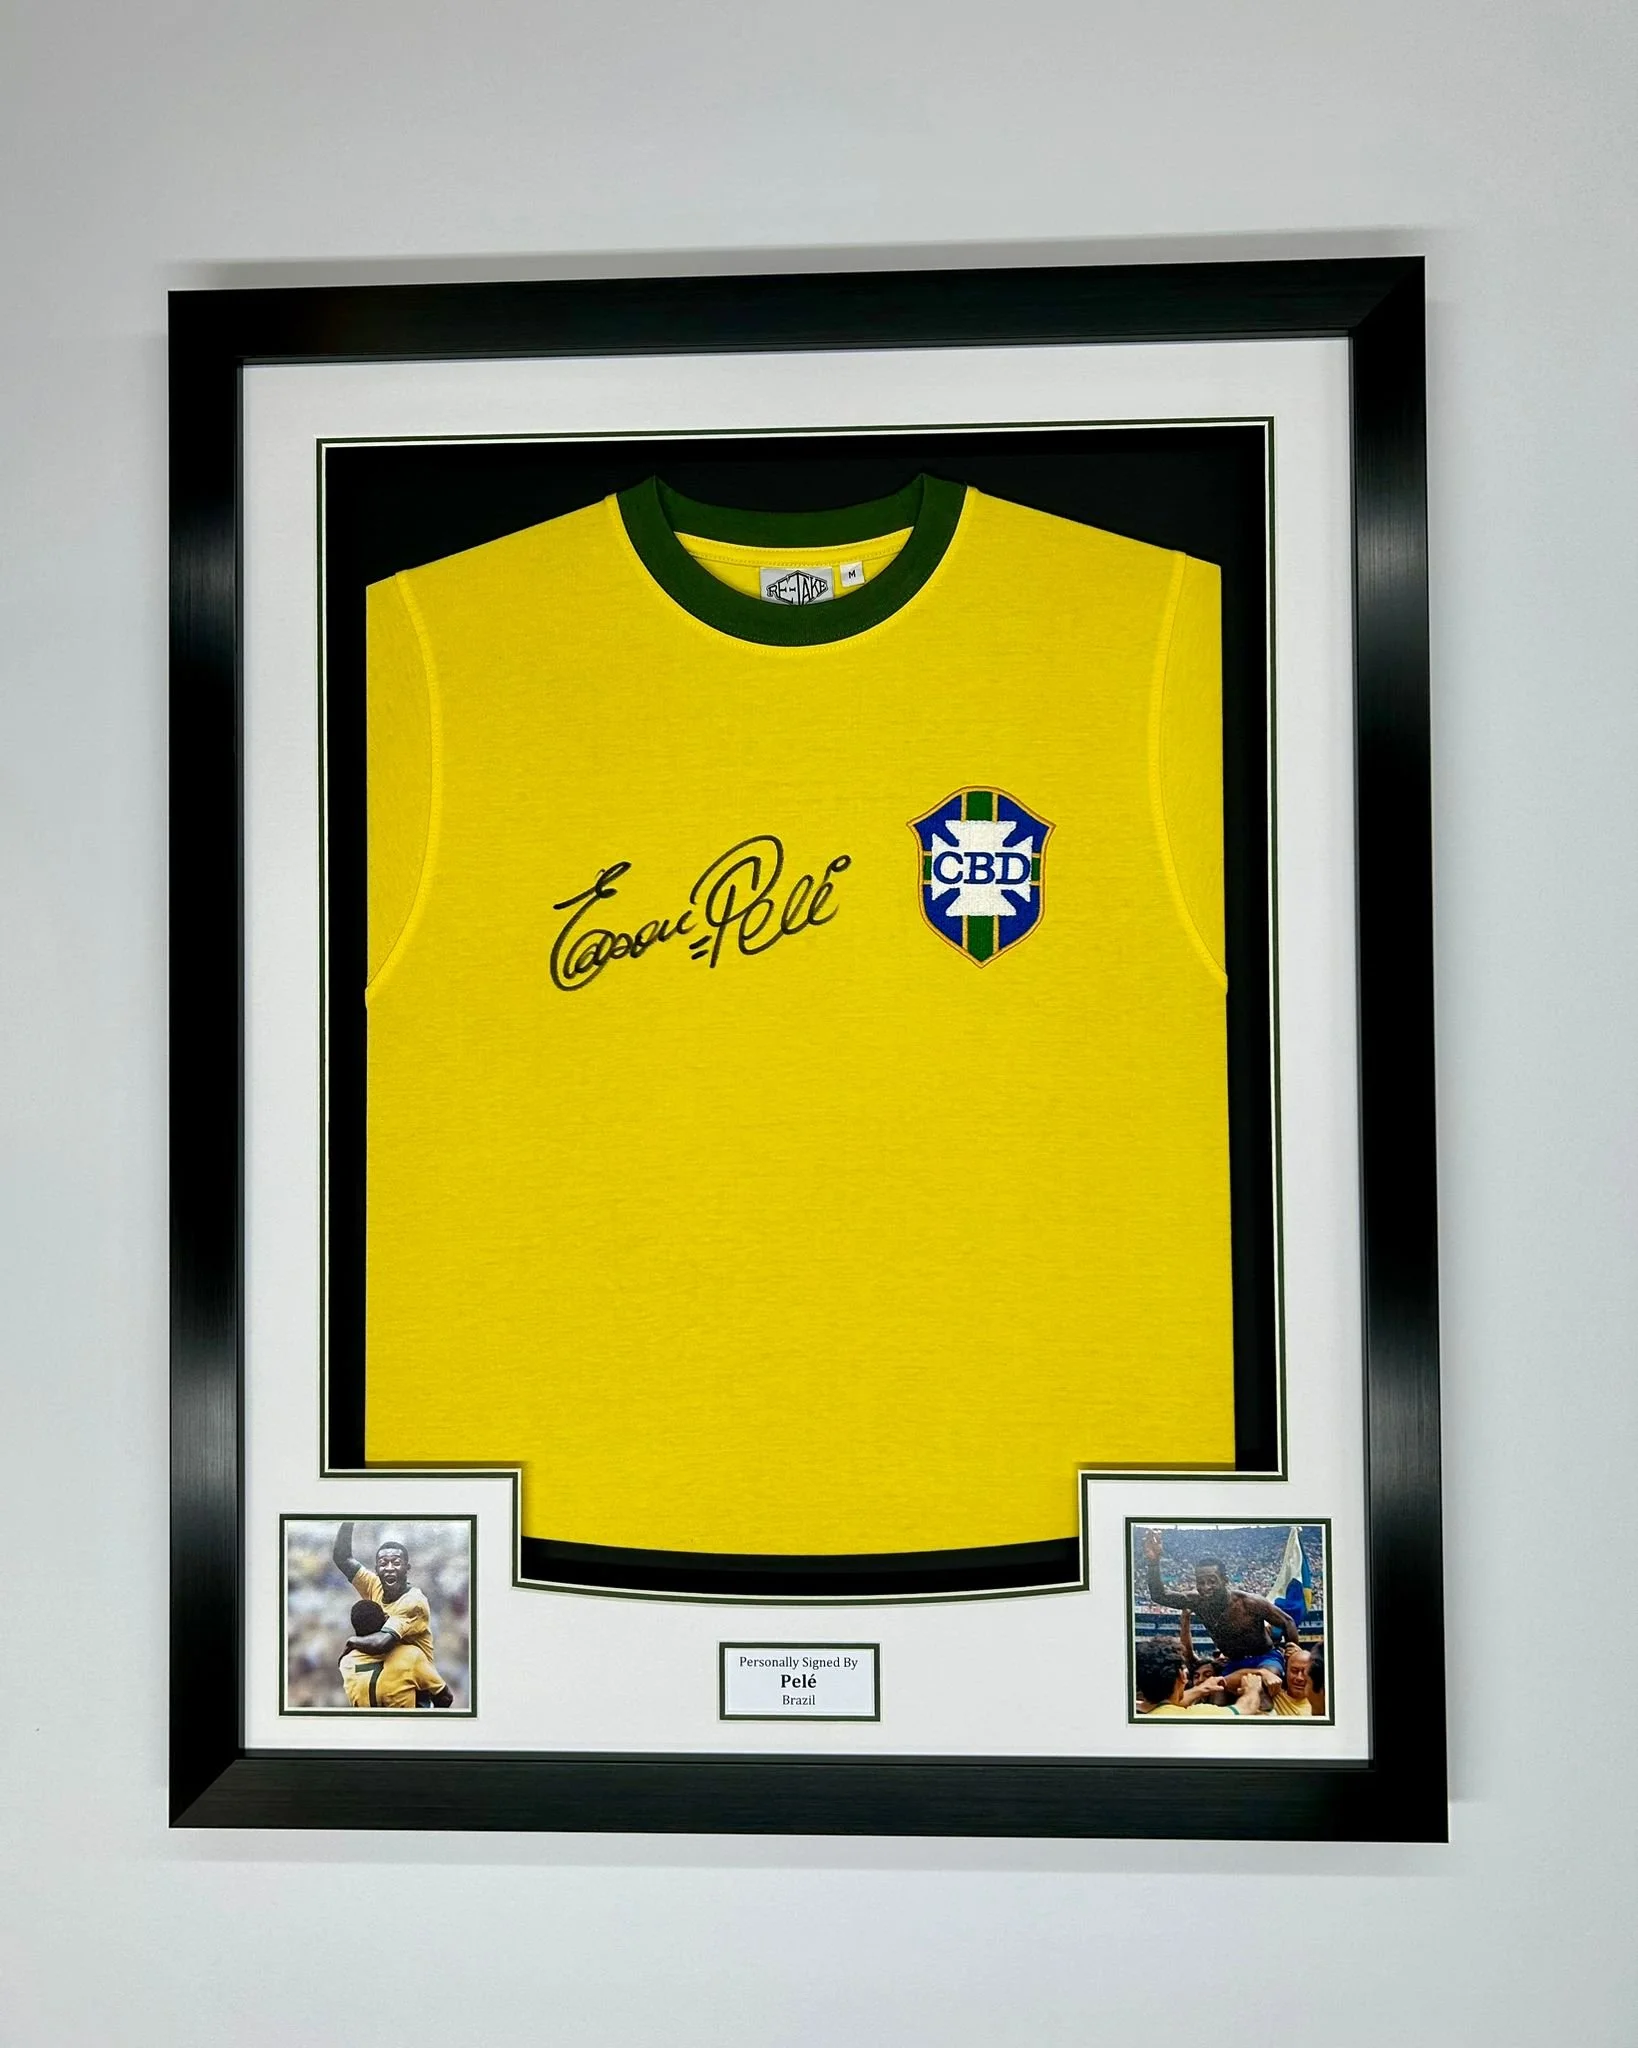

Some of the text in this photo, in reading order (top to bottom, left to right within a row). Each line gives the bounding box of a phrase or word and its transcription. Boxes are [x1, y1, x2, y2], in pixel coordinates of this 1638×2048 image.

[848, 570, 856, 579] M
[933, 851, 1031, 885] CBD
[739, 1656, 858, 1671] Personally Signed By
[355, 1662, 384, 1707] 7
[780, 1674, 817, 1688] Pelé
[782, 1694, 816, 1706] Brazil
